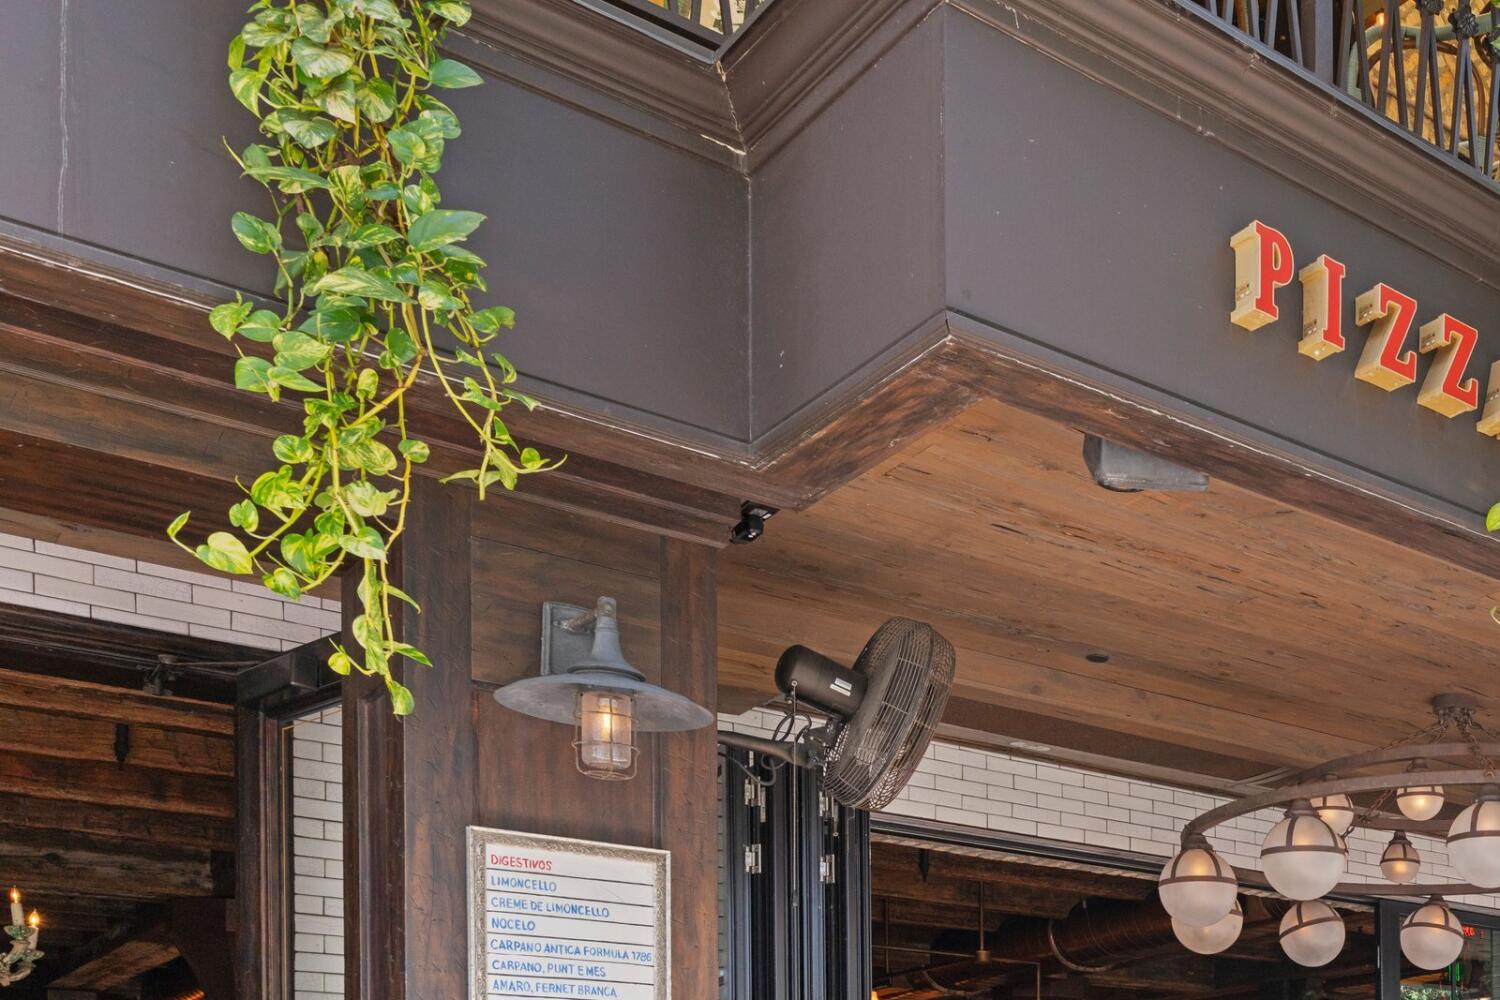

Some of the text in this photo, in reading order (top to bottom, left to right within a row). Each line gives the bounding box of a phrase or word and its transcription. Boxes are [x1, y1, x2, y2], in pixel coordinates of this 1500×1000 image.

[491, 854, 553, 871] DIGESTIVOS
[491, 875, 557, 892] LIMONCELLO
[491, 896, 610, 918] CREME DE LIMONCELLO
[491, 917, 536, 931] NOCELO
[490, 938, 653, 962] CARPANO ANTICA FORMULA 1786
[547, 963, 575, 975] PUNT
[578, 965, 584, 976] E
[586, 966, 606, 977] MES
[535, 982, 576, 994] FERNET
[578, 984, 617, 997] BRANCA
